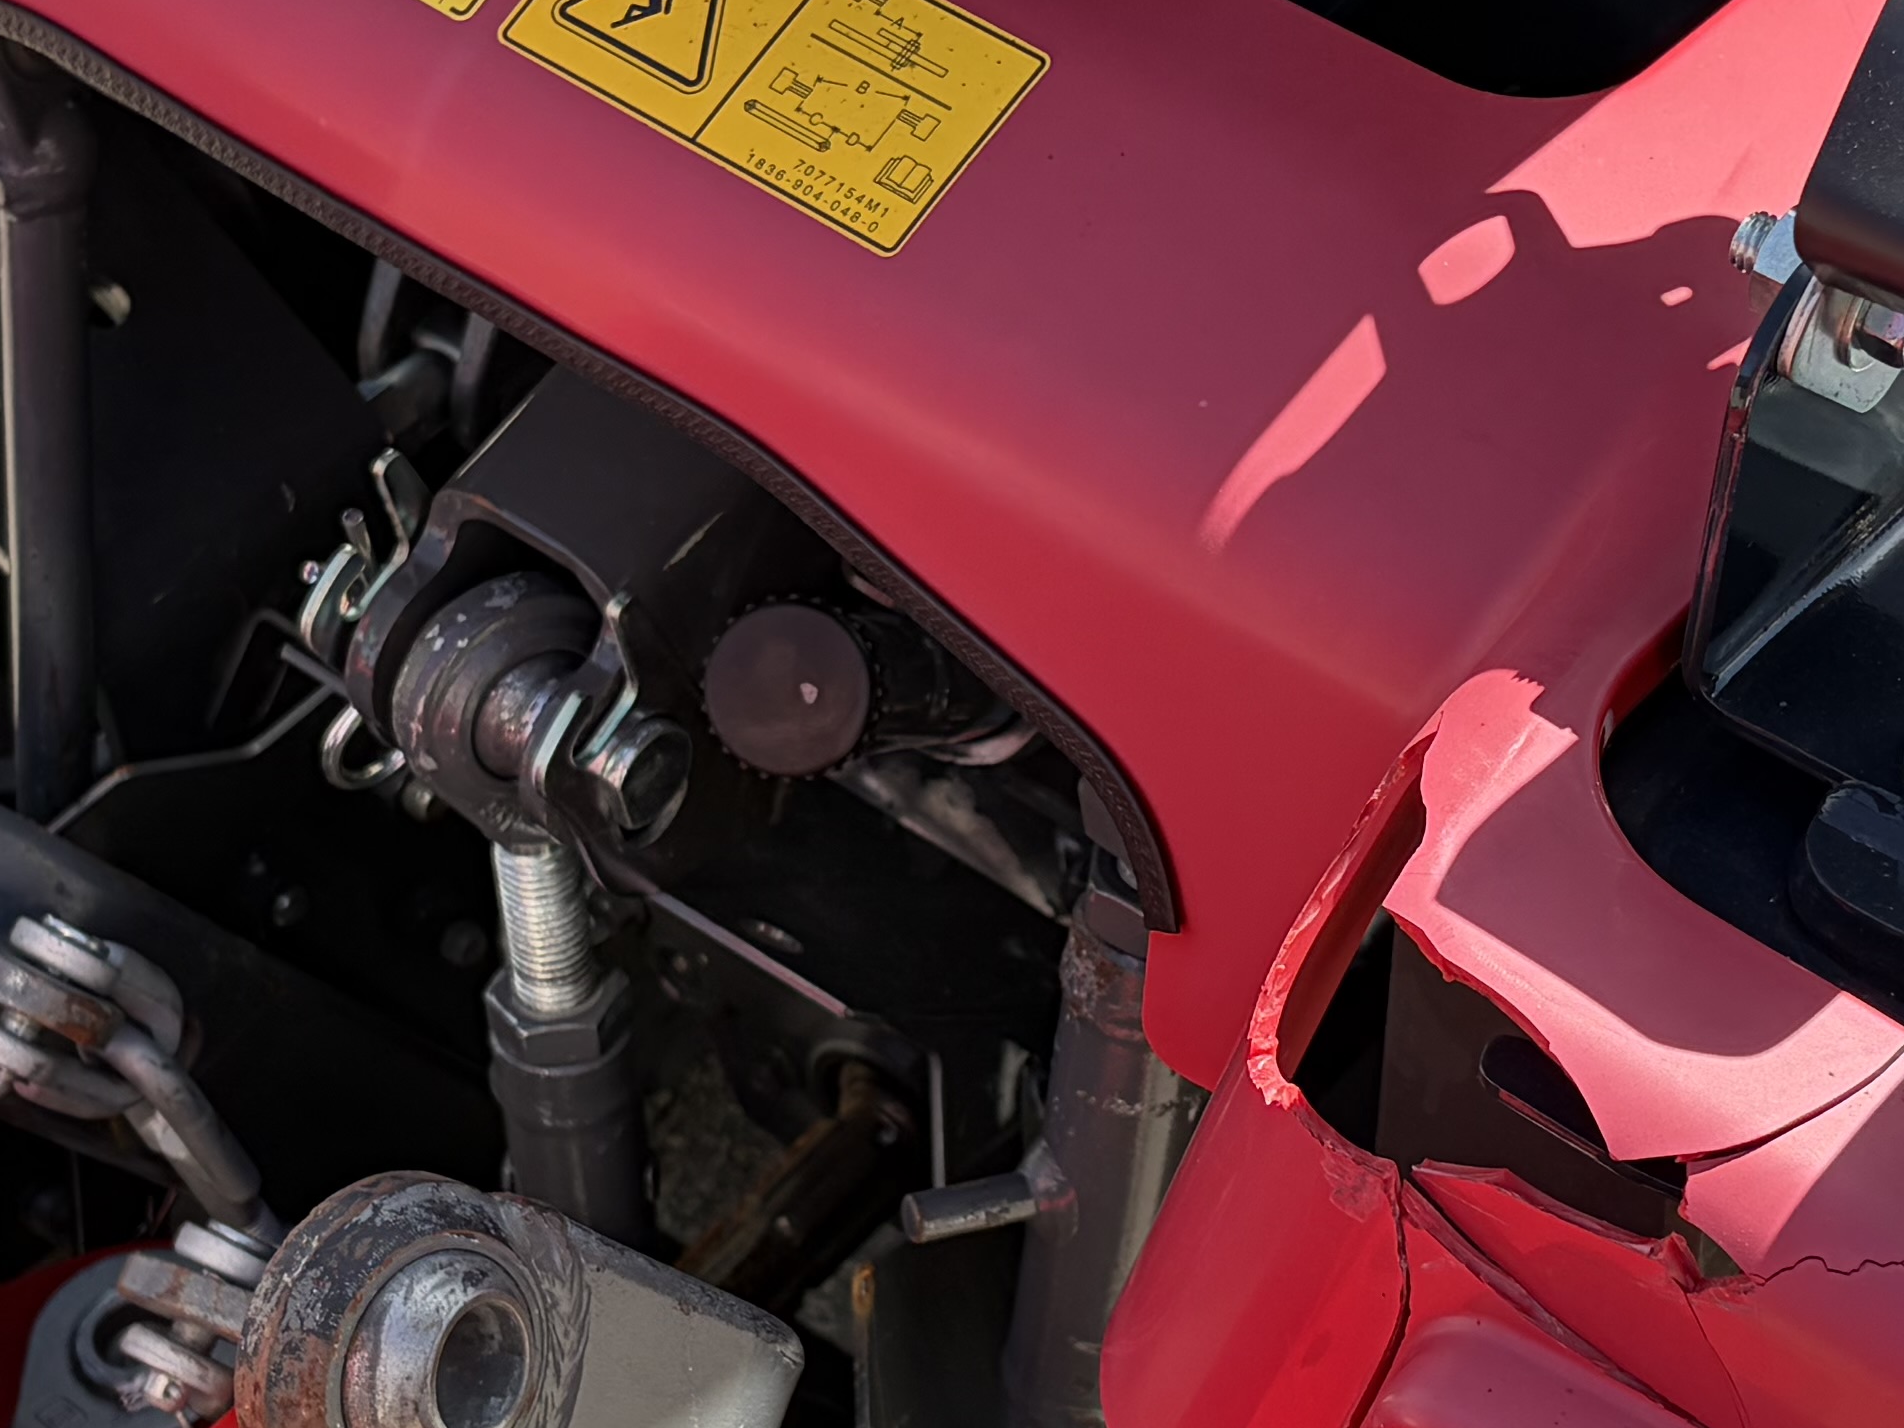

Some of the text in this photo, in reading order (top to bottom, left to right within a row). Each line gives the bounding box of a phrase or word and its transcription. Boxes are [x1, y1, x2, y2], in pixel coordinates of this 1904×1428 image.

[890, 16, 905, 30] A
[855, 80, 871, 95] B
[808, 112, 824, 126] C
[746, 152, 879, 233] 1836-904-048-0
[793, 158, 890, 218] 7077154M1
